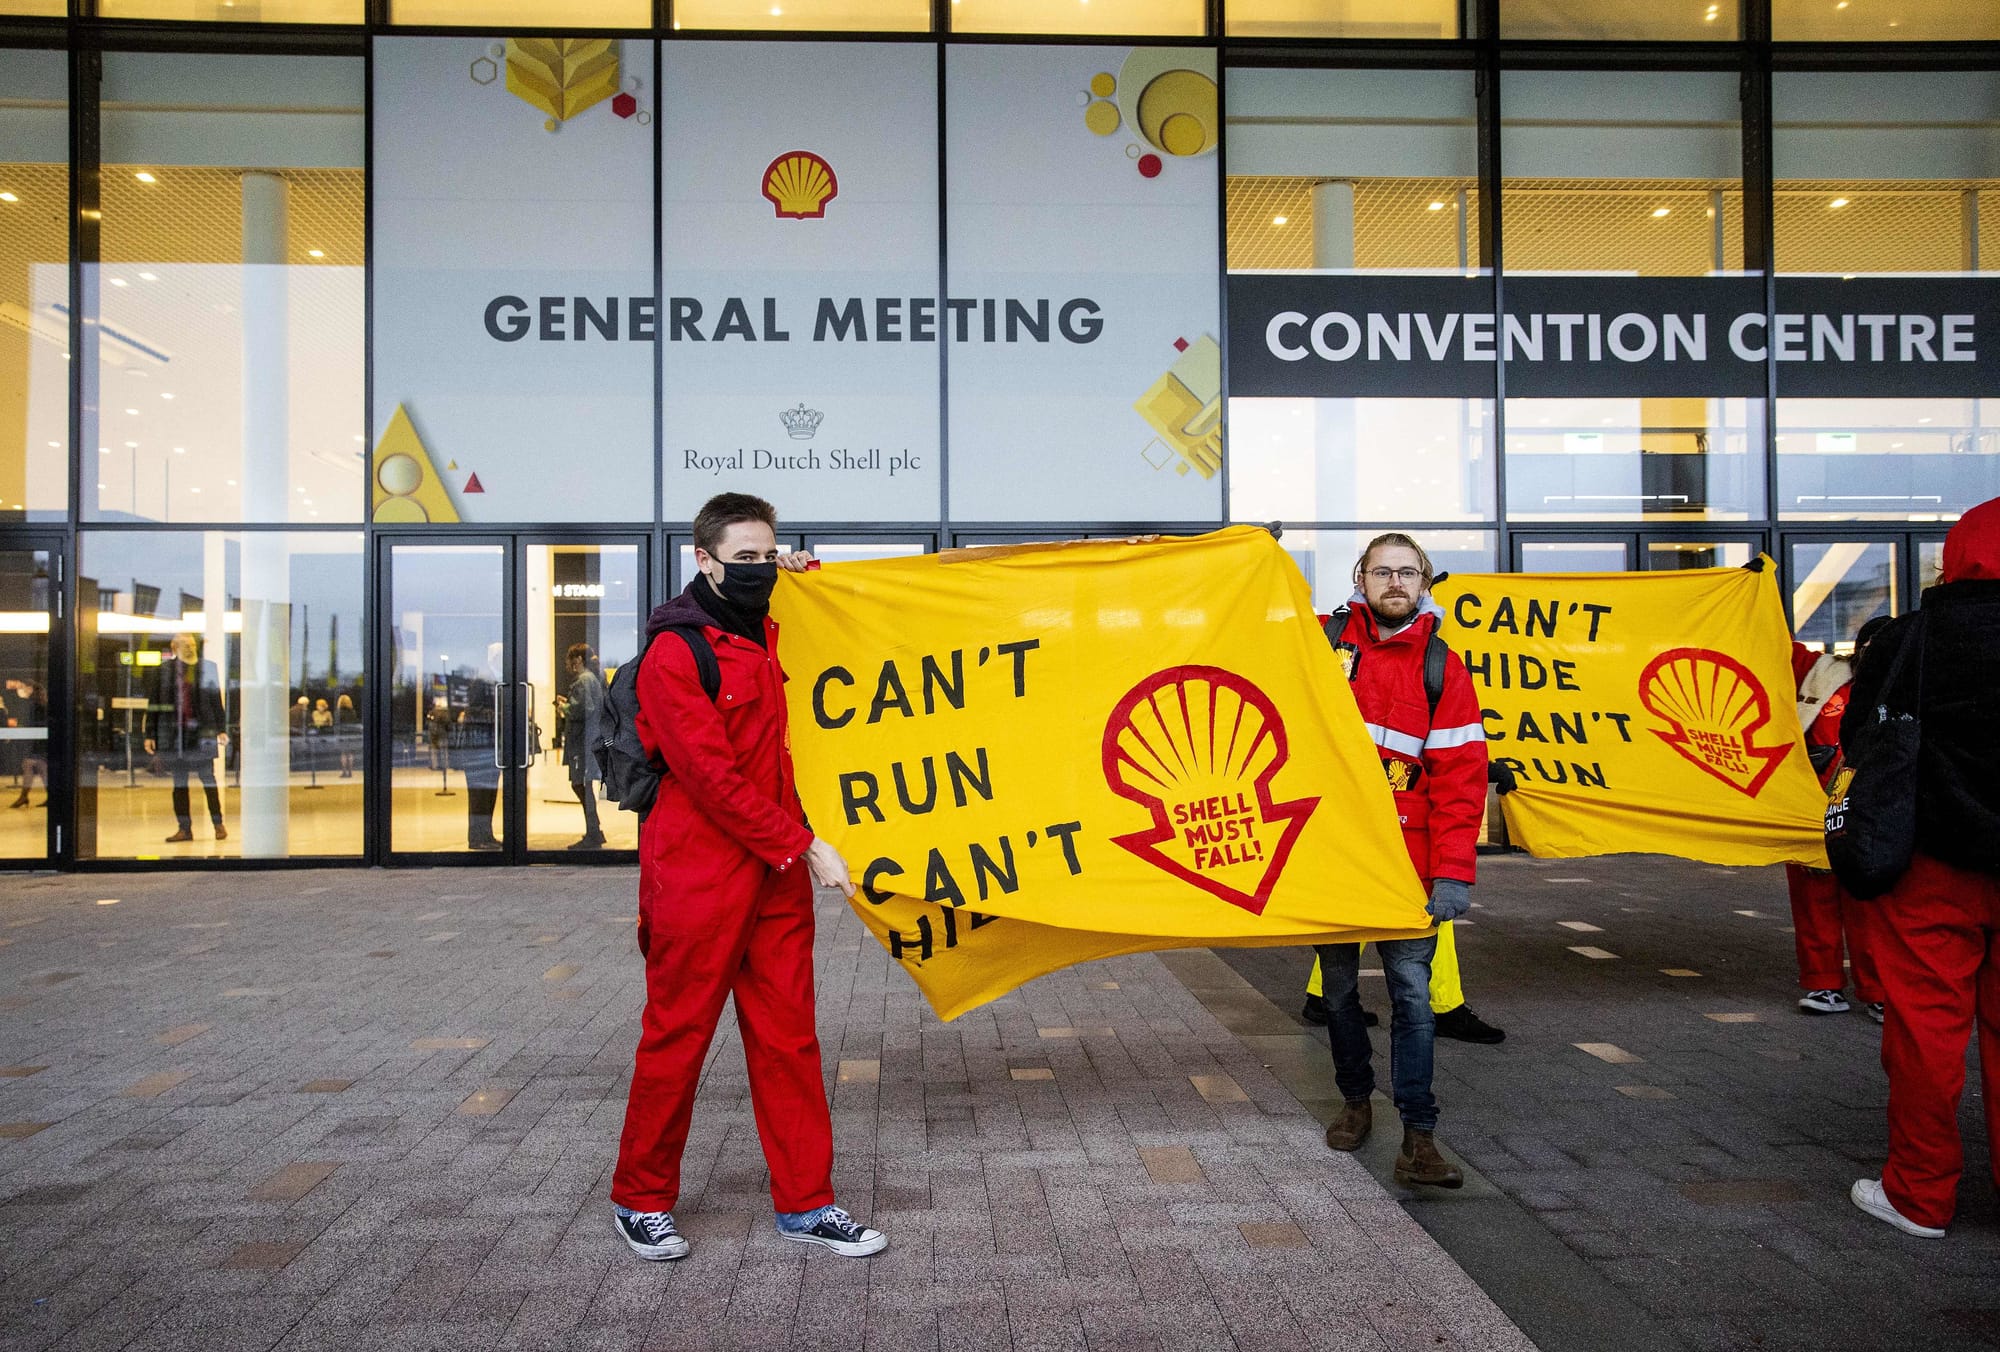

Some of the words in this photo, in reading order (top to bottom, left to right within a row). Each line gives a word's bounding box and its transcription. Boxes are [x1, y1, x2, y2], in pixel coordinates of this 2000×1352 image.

[484, 295, 789, 342] GENERAL
[812, 297, 1104, 344] MEETING
[1265, 311, 1706, 362] CONVENTION
[1728, 312, 1977, 362] CENTRE
[683, 449, 744, 477] Royal
[752, 449, 821, 471] Dutch
[829, 449, 881, 471] Shell
[889, 449, 921, 477] plc
[1454, 593, 1612, 642] CAN'T
[812, 638, 1040, 729] CAN'T
[1465, 650, 1581, 691] HIDE
[1480, 708, 1632, 744] CAN'T
[1688, 728, 1741, 749] SHELL
[1696, 741, 1742, 762] MUST
[1704, 753, 1750, 775] FALL!
[838, 747, 993, 825] RUN
[1495, 757, 1612, 790] RUN
[1173, 793, 1253, 824] SHELL
[1825, 797, 1850, 818] ANGE
[1825, 815, 1844, 833] RLD
[1184, 816, 1255, 848] MUST
[862, 820, 1082, 908] CAN'T
[1194, 840, 1264, 870] FALL!
[888, 905, 1000, 961] HI
